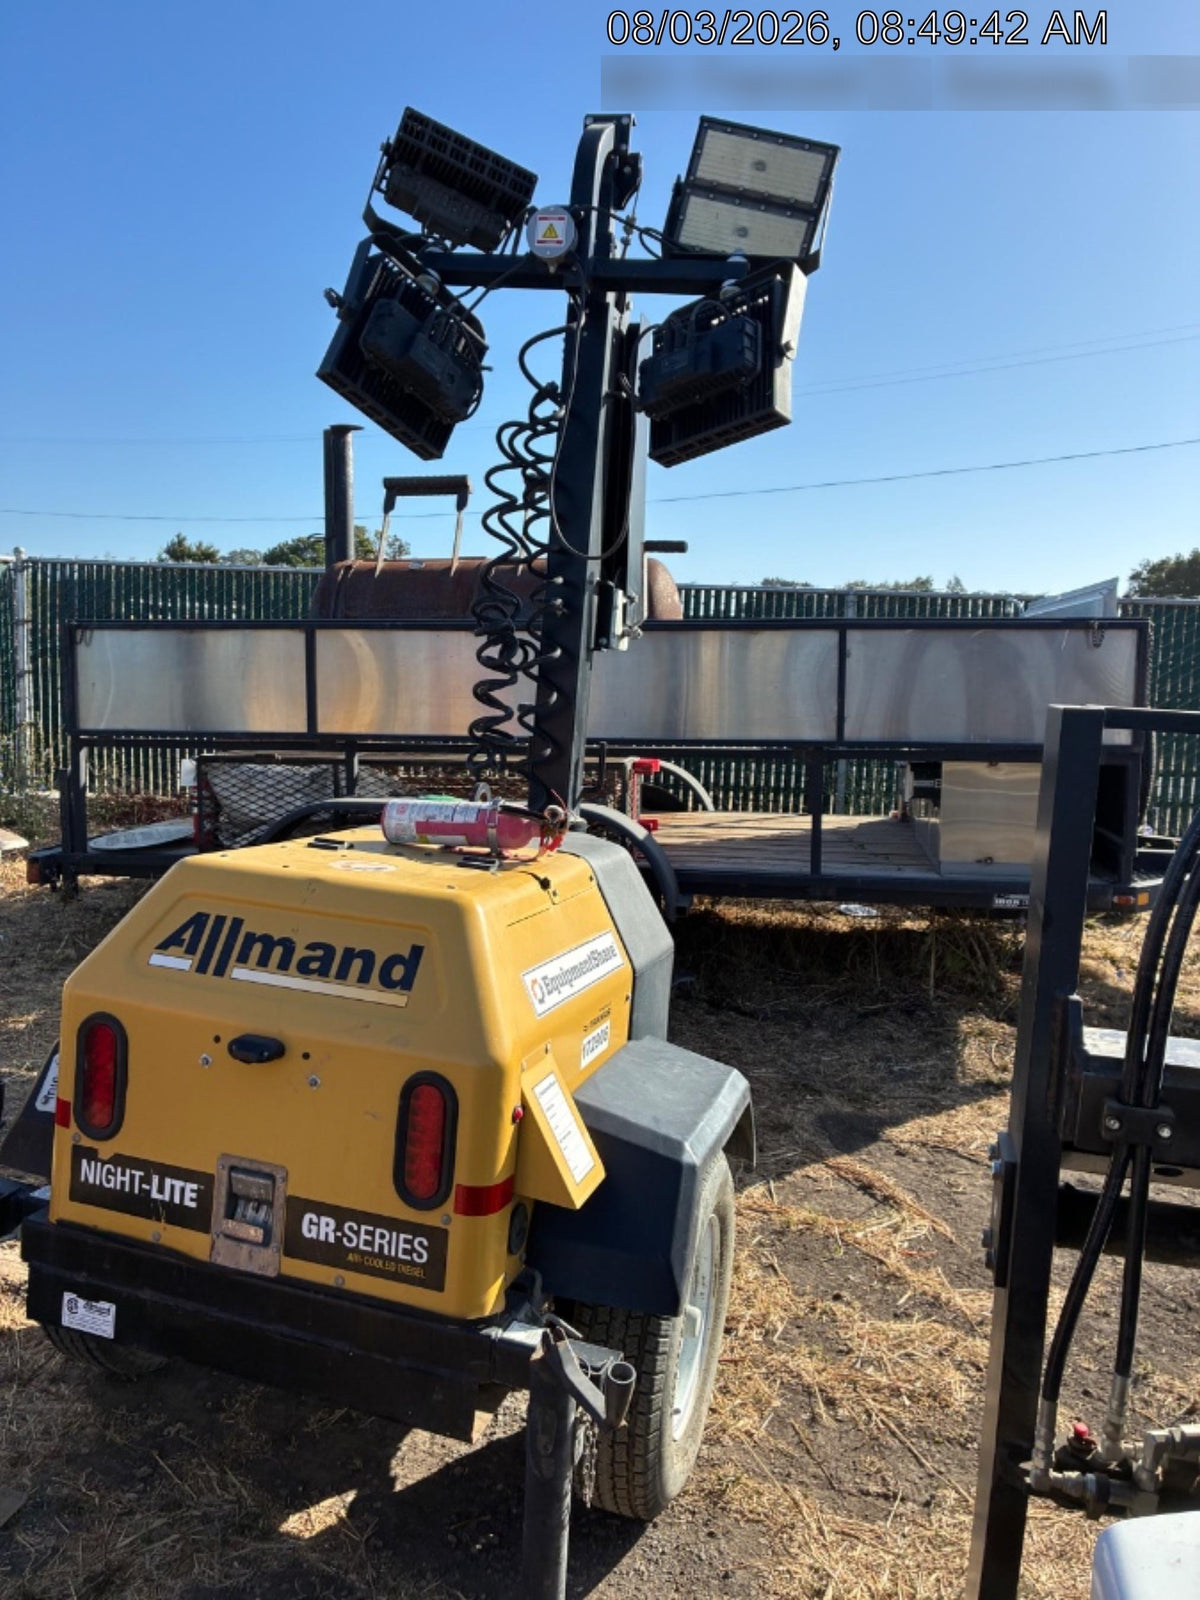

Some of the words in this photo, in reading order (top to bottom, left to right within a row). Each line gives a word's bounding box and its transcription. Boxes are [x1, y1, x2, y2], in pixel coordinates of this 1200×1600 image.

[155, 911, 425, 992] Allmand
[542, 945, 618, 996] EquipmentShare
[81, 1158, 199, 1208] NIGHT-LITE
[301, 1212, 430, 1264] GR-SERIES
